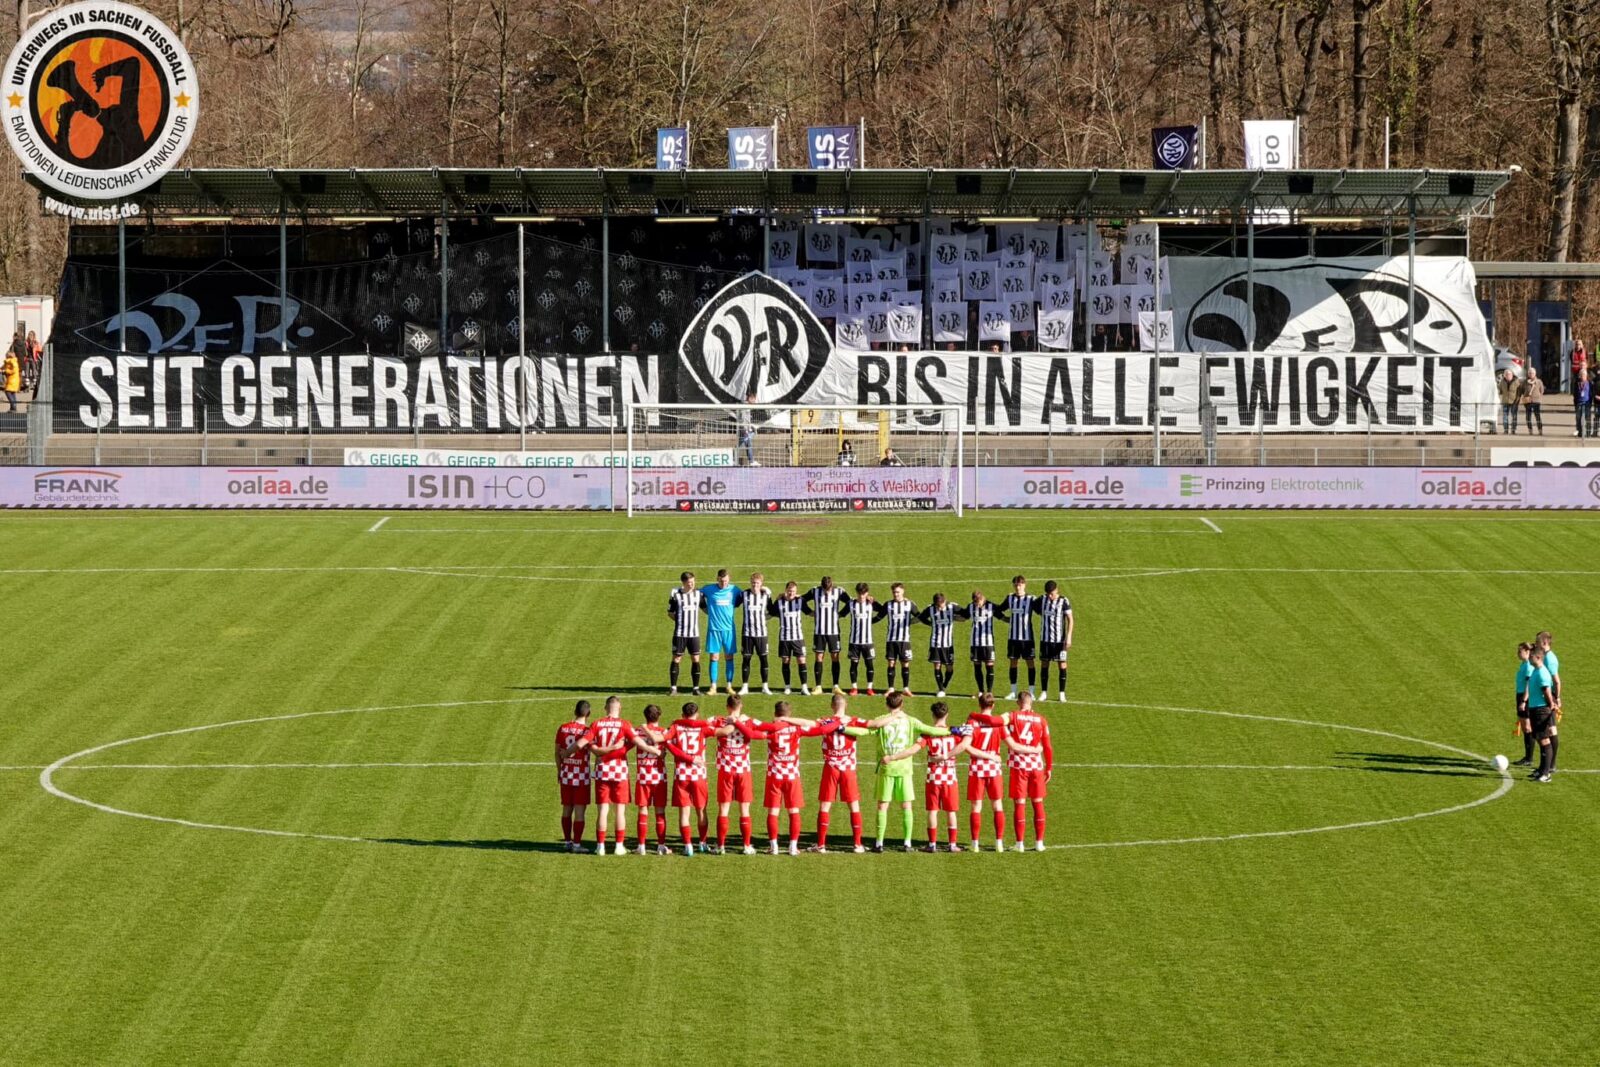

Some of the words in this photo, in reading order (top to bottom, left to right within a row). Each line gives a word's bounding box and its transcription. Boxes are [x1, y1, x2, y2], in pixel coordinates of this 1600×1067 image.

[79, 355, 204, 428] SEIT
[221, 355, 660, 428] GENERATIONEN
[857, 355, 947, 426] BIS
[966, 356, 1022, 426] IN
[1041, 357, 1180, 426] ALLE
[1200, 356, 1474, 426] EWIGKEIT
[370, 454, 418, 466] GEIGER
[448, 456, 496, 467] GEIGER
[526, 457, 574, 468] GEIGER
[682, 454, 730, 466] GEIGER
[34, 479, 120, 493] FRANK
[228, 476, 328, 494] oalaa.de
[626, 476, 726, 495] oalaa.de
[870, 480, 879, 492] &
[882, 480, 942, 494] Weißkopf
[1024, 476, 1124, 494] oalaa.de
[1206, 478, 1265, 493] Prinzing
[1271, 478, 1364, 490] Elektrotechnik
[1422, 476, 1522, 495] oalaa.de
[598, 728, 620, 748] 17
[980, 728, 993, 750] 7
[1020, 722, 1034, 744] 4
[680, 732, 700, 754] 13
[778, 735, 790, 754] 5
